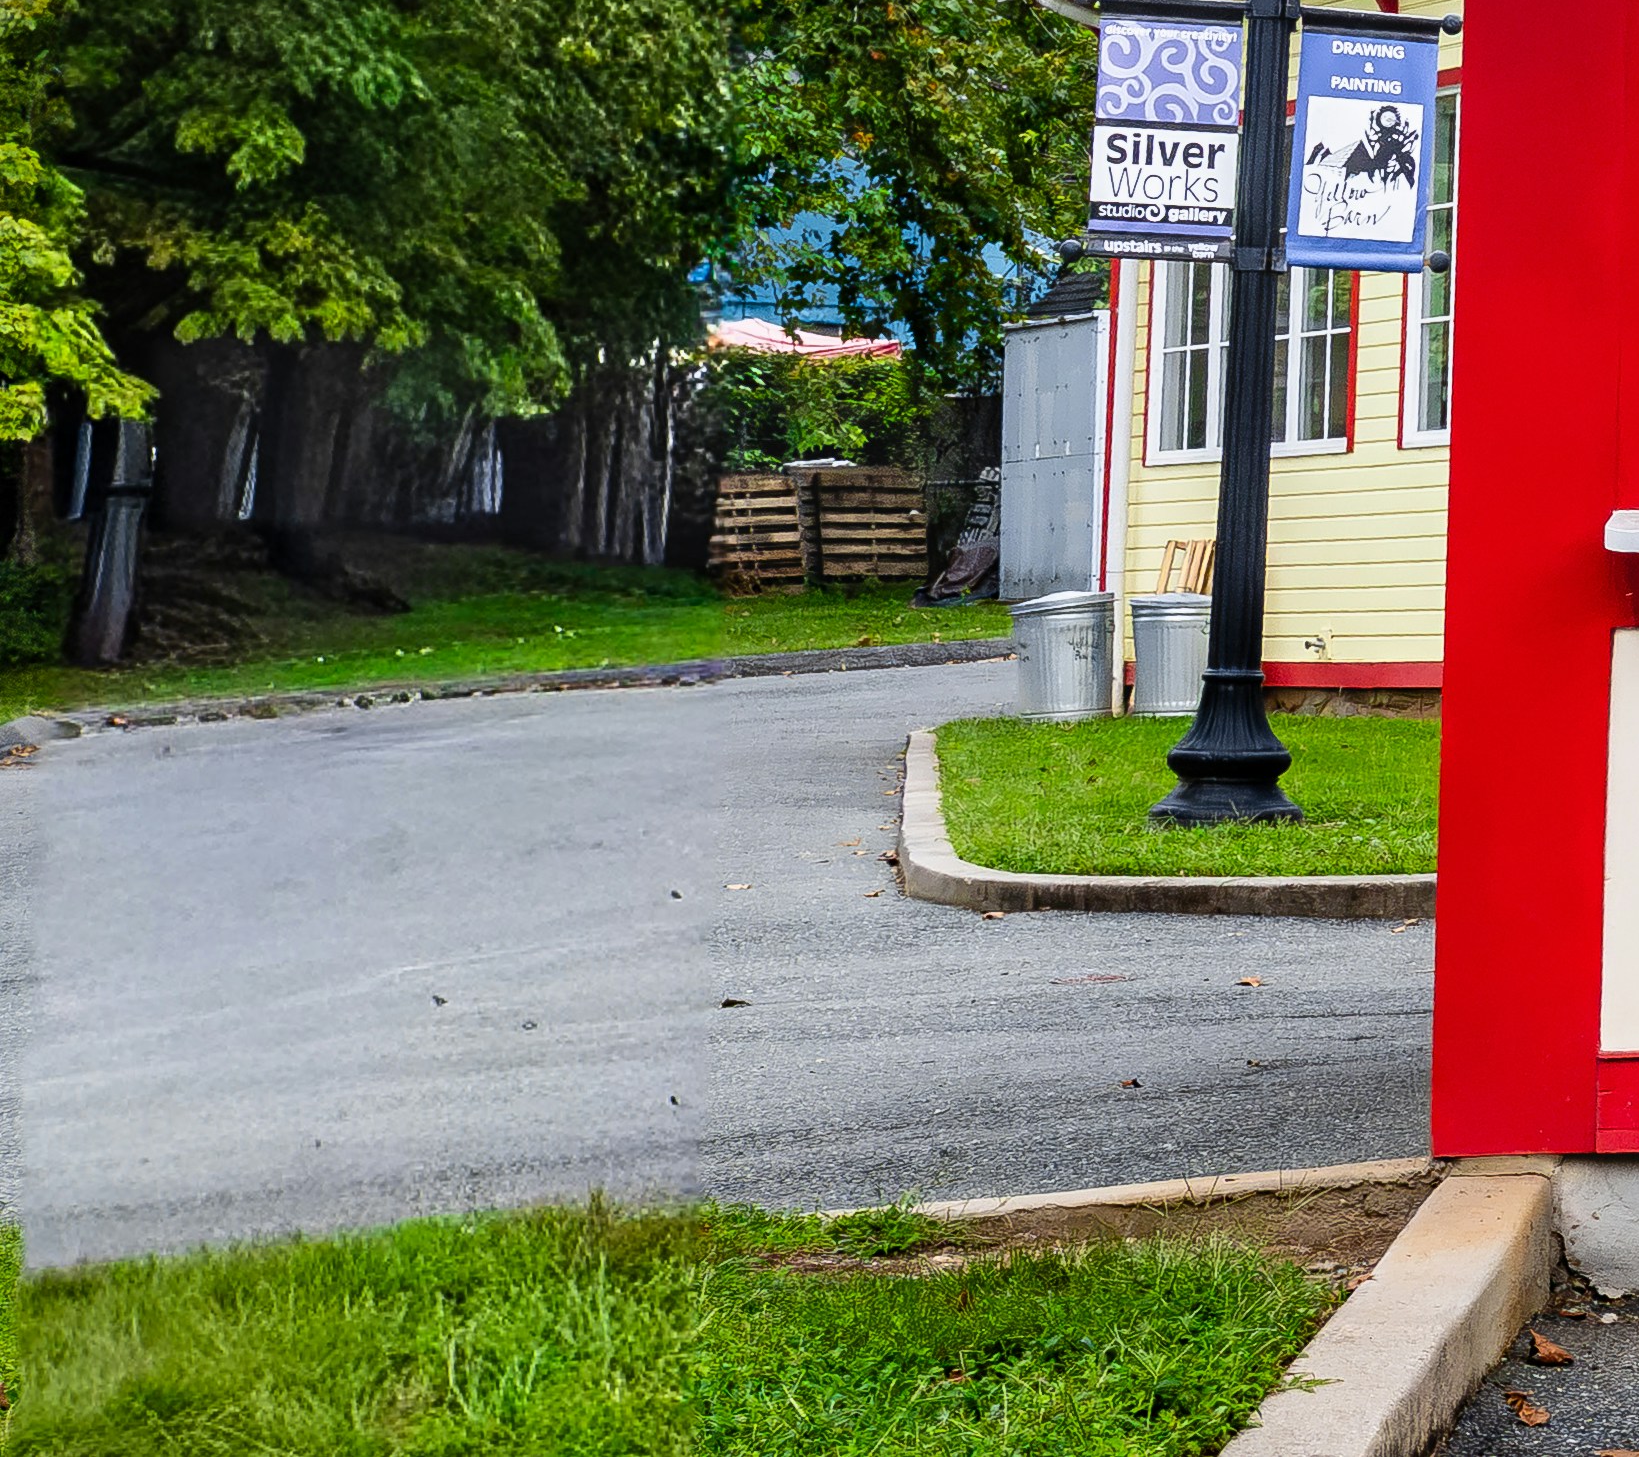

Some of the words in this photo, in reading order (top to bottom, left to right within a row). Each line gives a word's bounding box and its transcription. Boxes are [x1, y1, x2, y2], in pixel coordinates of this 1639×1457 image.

[1104, 22, 1151, 37] discover
[1154, 28, 1180, 39] your
[1183, 30, 1238, 43] creativity!
[1331, 40, 1406, 60] DRAWING
[1363, 61, 1375, 74] &
[1330, 75, 1403, 95] PAINTING
[1106, 132, 1226, 170] Silver
[1108, 166, 1219, 203] Works
[1304, 172, 1382, 219] Yellow
[1098, 203, 1146, 219] studio
[1167, 207, 1228, 225] gallery
[1321, 200, 1392, 236] Barn
[1103, 239, 1163, 254] upstairs
[1187, 242, 1219, 253] yellow
[1192, 250, 1215, 259] barn
